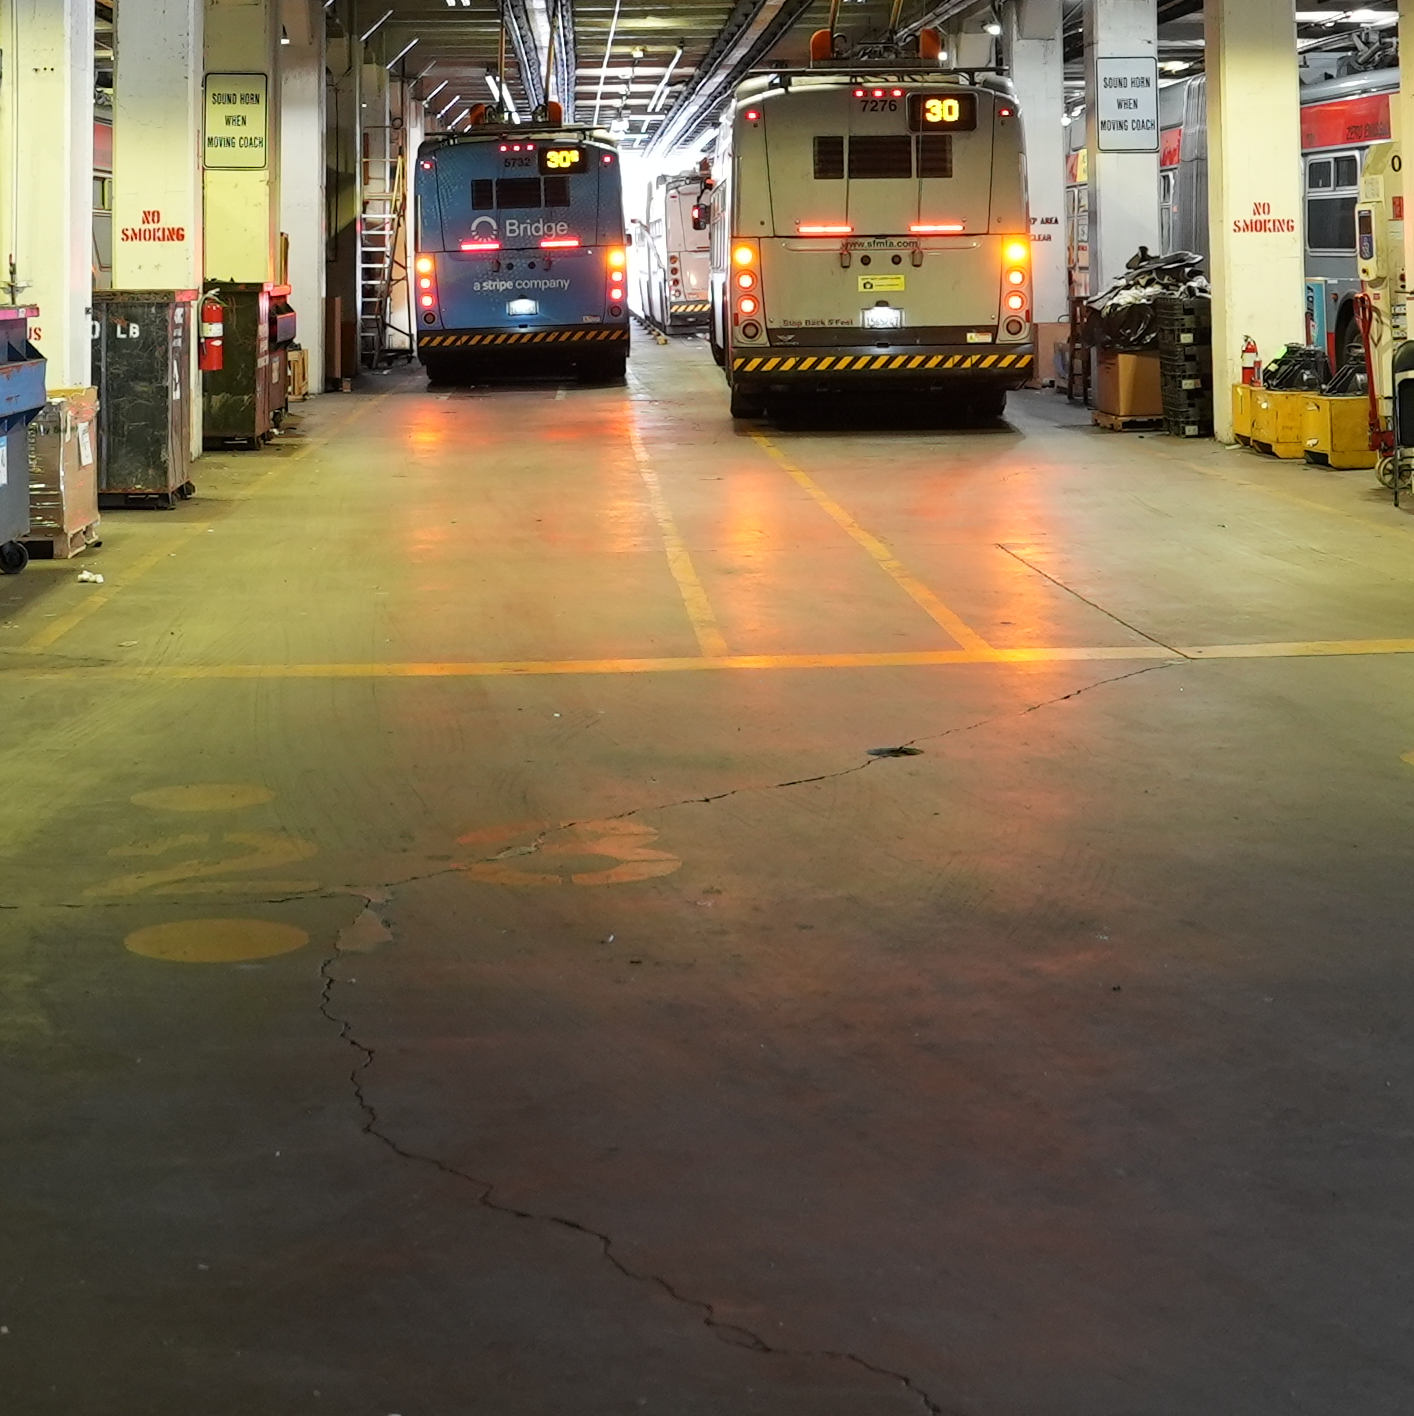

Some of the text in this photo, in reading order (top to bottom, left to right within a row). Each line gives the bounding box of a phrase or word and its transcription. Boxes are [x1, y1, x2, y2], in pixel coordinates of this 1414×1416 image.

[1103, 76, 1151, 88] SOUND HORN
[211, 93, 261, 105] SOUND HORN
[860, 99, 898, 112] 7276
[1116, 98, 1138, 109] WHEN
[925, 98, 960, 122] 30
[224, 115, 247, 126] WHEN
[1100, 119, 1156, 131] MOVING COACH
[207, 136, 264, 148] MOVING COACH
[504, 157, 531, 168] 5732
[1252, 202, 1271, 216] NO
[142, 209, 161, 224] NO
[1040, 217, 1059, 225] AREA
[505, 218, 569, 239] Bridge
[1232, 218, 1295, 233] SMOKING
[121, 226, 185, 242] SMOKING
[473, 277, 571, 292] a stripe company
[116, 322, 140, 339] LB
